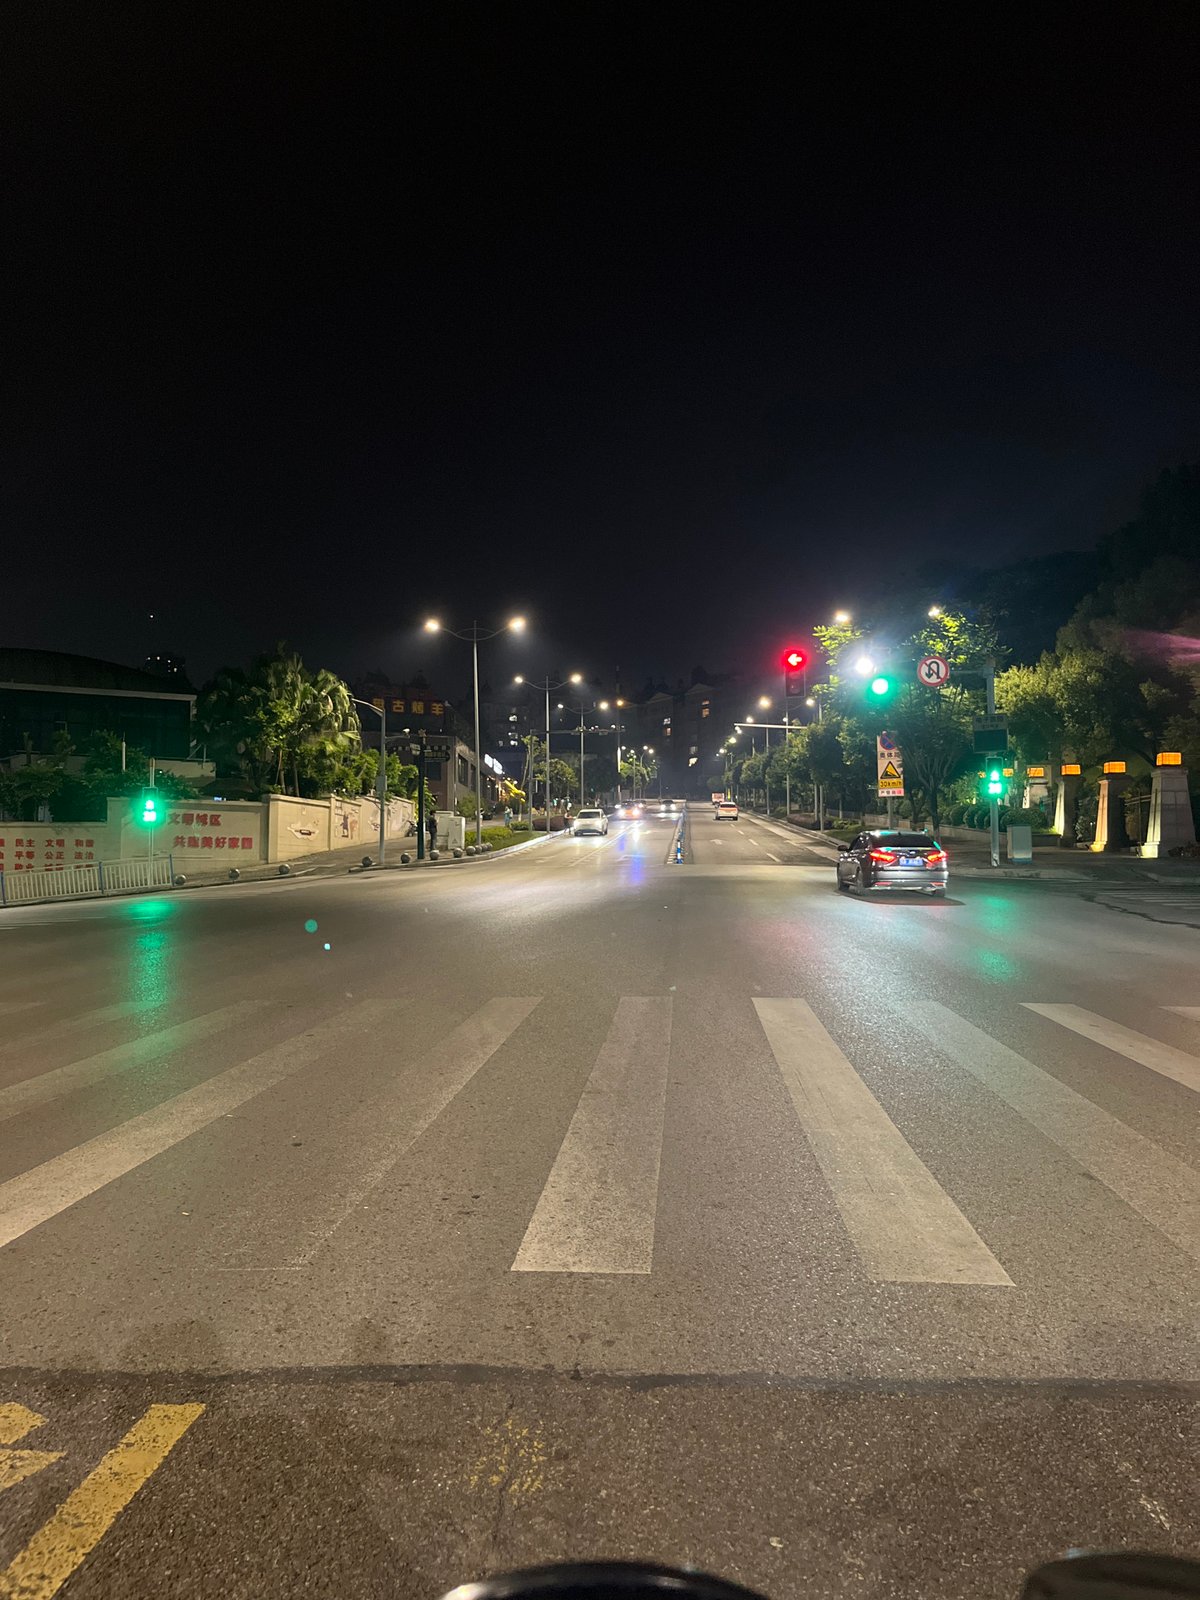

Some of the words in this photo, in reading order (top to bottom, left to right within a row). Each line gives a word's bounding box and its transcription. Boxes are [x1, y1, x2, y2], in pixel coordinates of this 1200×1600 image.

[15, 839, 35, 847] 民主
[45, 839, 65, 847] 文明
[15, 851, 35, 860] 平等
[45, 851, 64, 859] 公正
